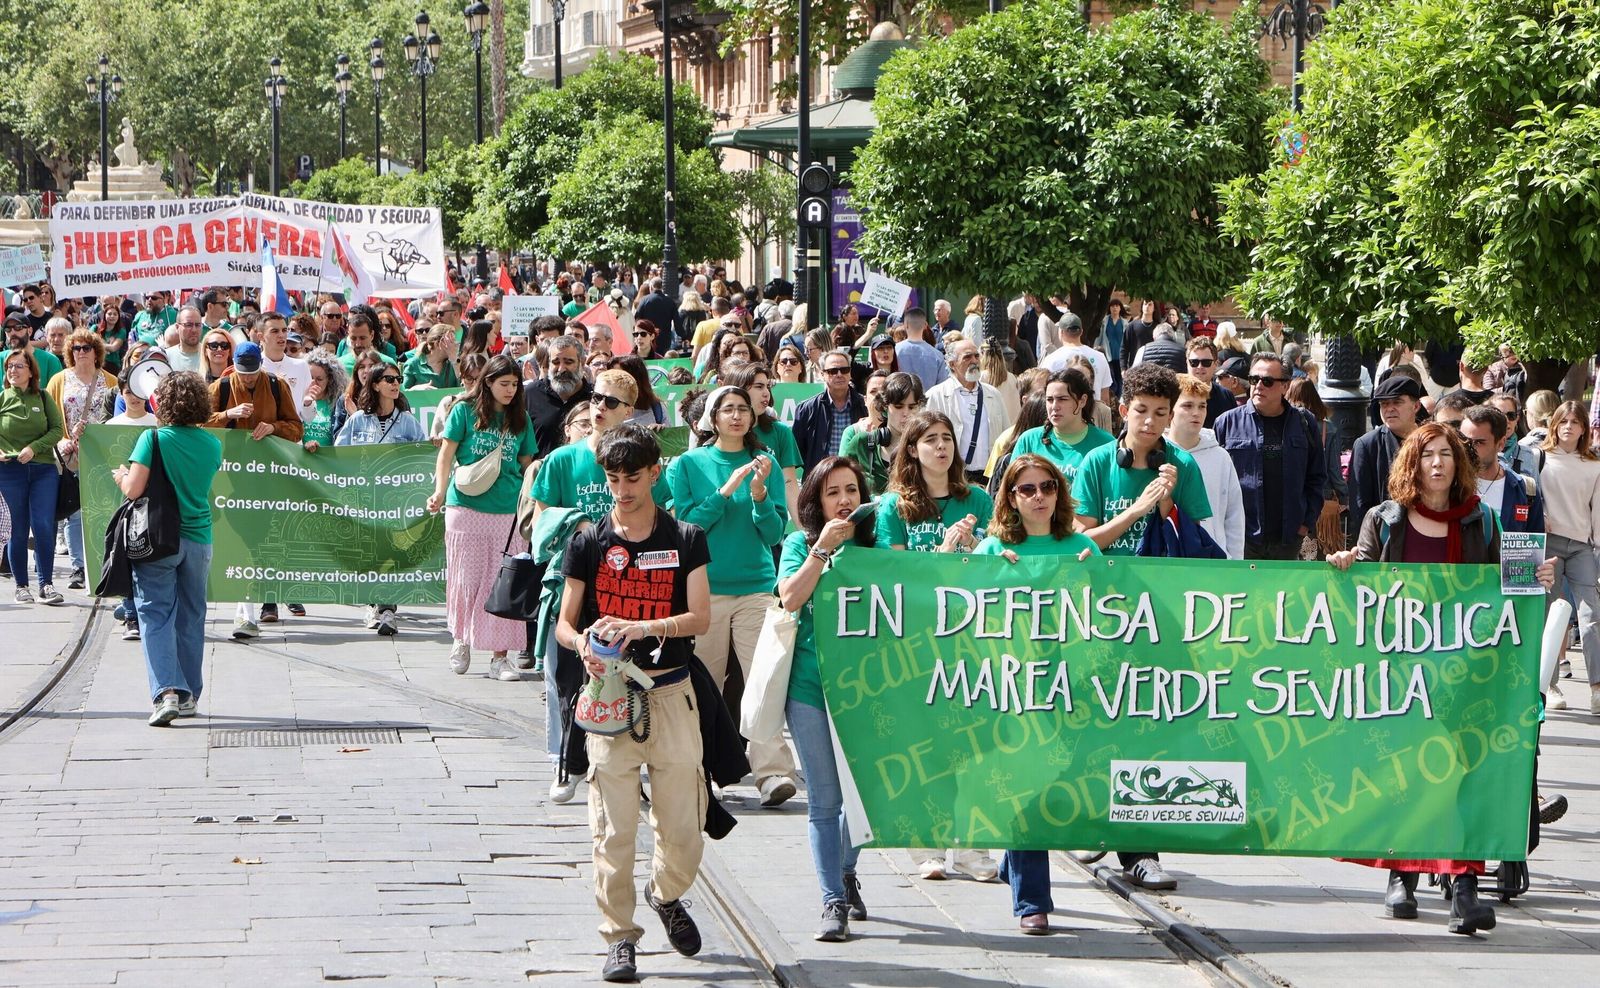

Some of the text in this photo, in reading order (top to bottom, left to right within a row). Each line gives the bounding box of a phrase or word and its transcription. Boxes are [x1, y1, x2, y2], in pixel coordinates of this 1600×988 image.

[301, 155, 310, 170] P
[60, 206, 91, 221] PARA
[93, 204, 156, 220] DEFENDER
[159, 203, 185, 219] UNA
[188, 199, 237, 214] ESCUELA
[294, 202, 309, 218] DE
[368, 208, 377, 225] Y
[381, 208, 431, 225] SEGURA
[63, 216, 325, 270] ¡HUELGA GENERA
[64, 262, 211, 287] IZQUIERDA REVOLUCIONARIA
[227, 260, 321, 278] Sindica de Estu
[835, 258, 870, 284] TA
[218, 458, 242, 472] tro
[246, 459, 266, 473] de
[270, 460, 320, 481] trabajo
[323, 473, 370, 488] digno,
[374, 471, 425, 487] seguro
[429, 471, 437, 484] y
[214, 495, 318, 513] Conservatorio
[322, 502, 401, 519] Profesional
[405, 505, 424, 518] de
[1502, 540, 1540, 549] HUELGA
[225, 565, 448, 584] #SOSConservatorioDanzaSevil
[596, 573, 673, 600] BARRIO
[627, 567, 648, 582] DE
[651, 569, 675, 584] UN
[836, 583, 904, 638] EN
[934, 585, 1160, 644] DEFENSA
[1181, 590, 1250, 644] DE
[1275, 590, 1338, 645] LA
[1355, 580, 1522, 653] PÚBLICA
[925, 653, 1433, 722] MAREA VERDE SEVILLA
[1111, 809, 1244, 822] MAREA VERDE SEVILLA
[1249, 766, 1383, 850] PARA
